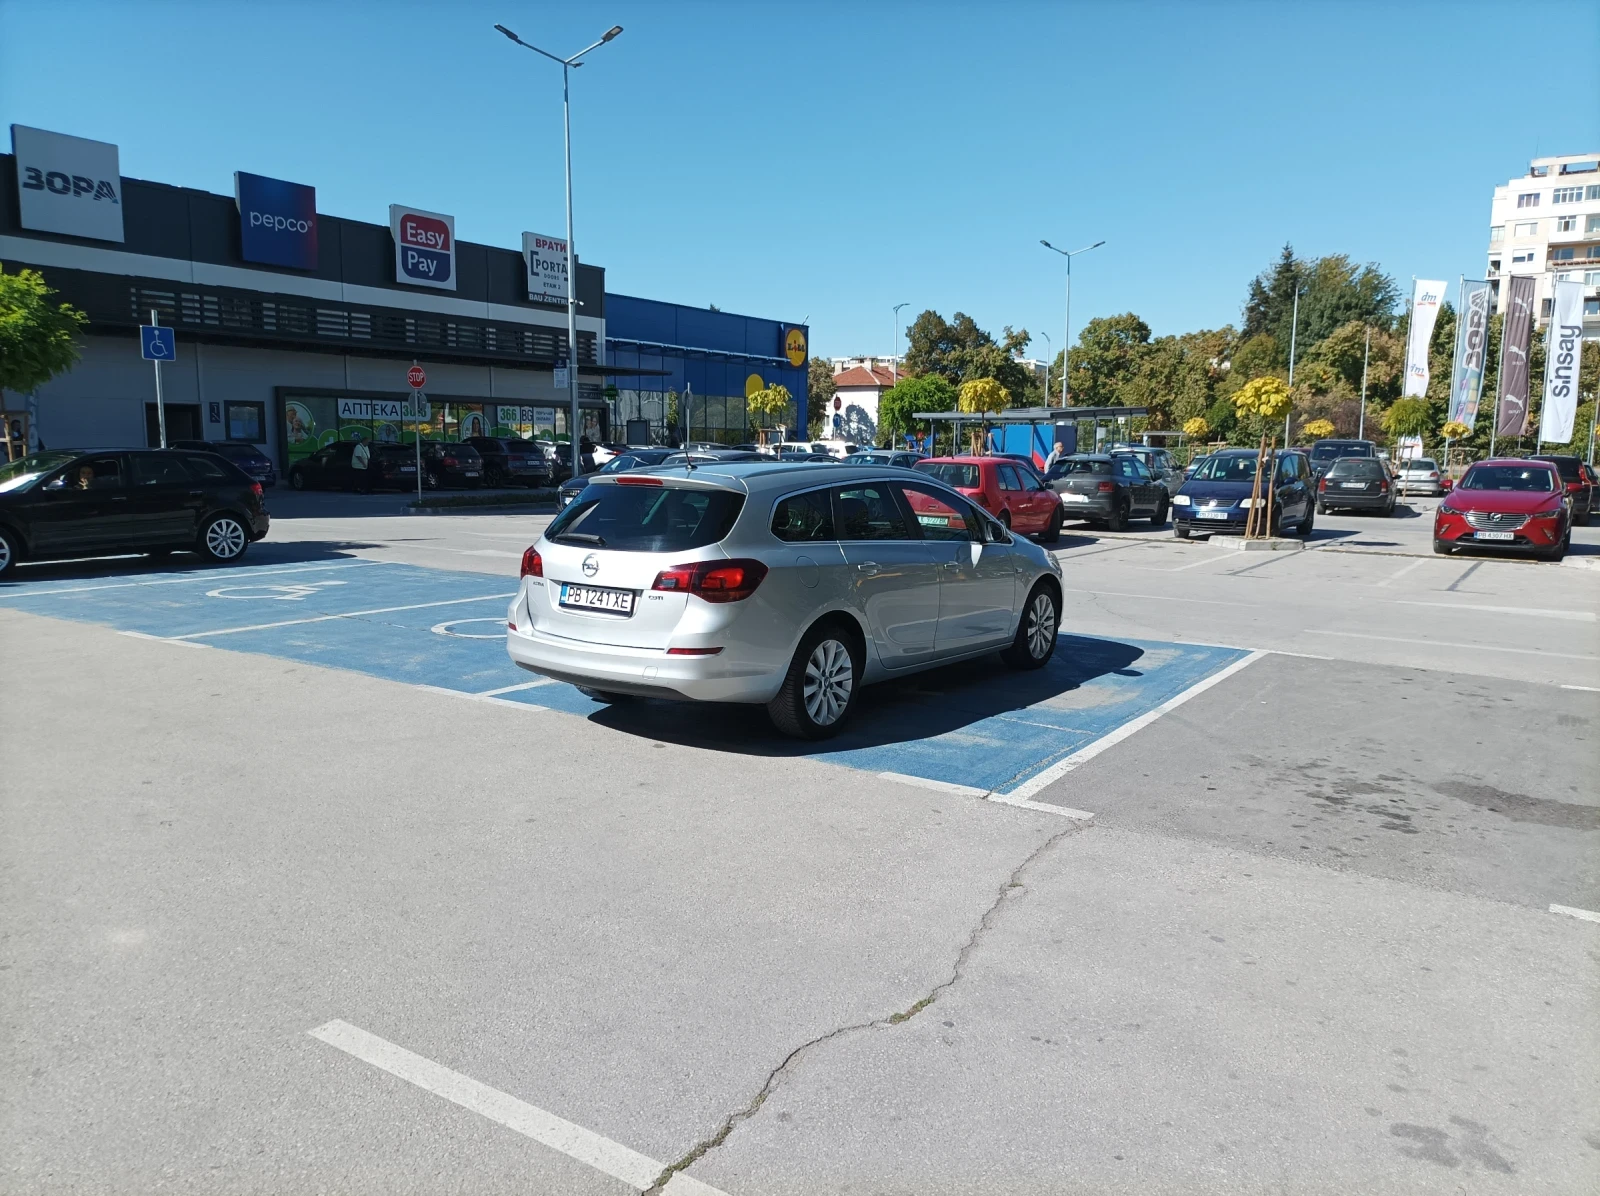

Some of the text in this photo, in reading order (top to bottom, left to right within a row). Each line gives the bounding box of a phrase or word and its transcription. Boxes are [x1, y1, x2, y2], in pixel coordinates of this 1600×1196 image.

[22, 166, 119, 204] ЗОРА
[406, 221, 445, 249] Easy
[535, 238, 567, 253] ВРАТИ
[407, 250, 437, 277] Pay
[535, 258, 568, 275] PORTA
[529, 293, 543, 302] BAU
[1421, 292, 1437, 302] dm
[1549, 325, 1583, 398] Sinsay
[408, 372, 424, 382] STOP
[342, 402, 399, 417] АПТЕКА
[567, 586, 630, 609] PB 1241 XE
